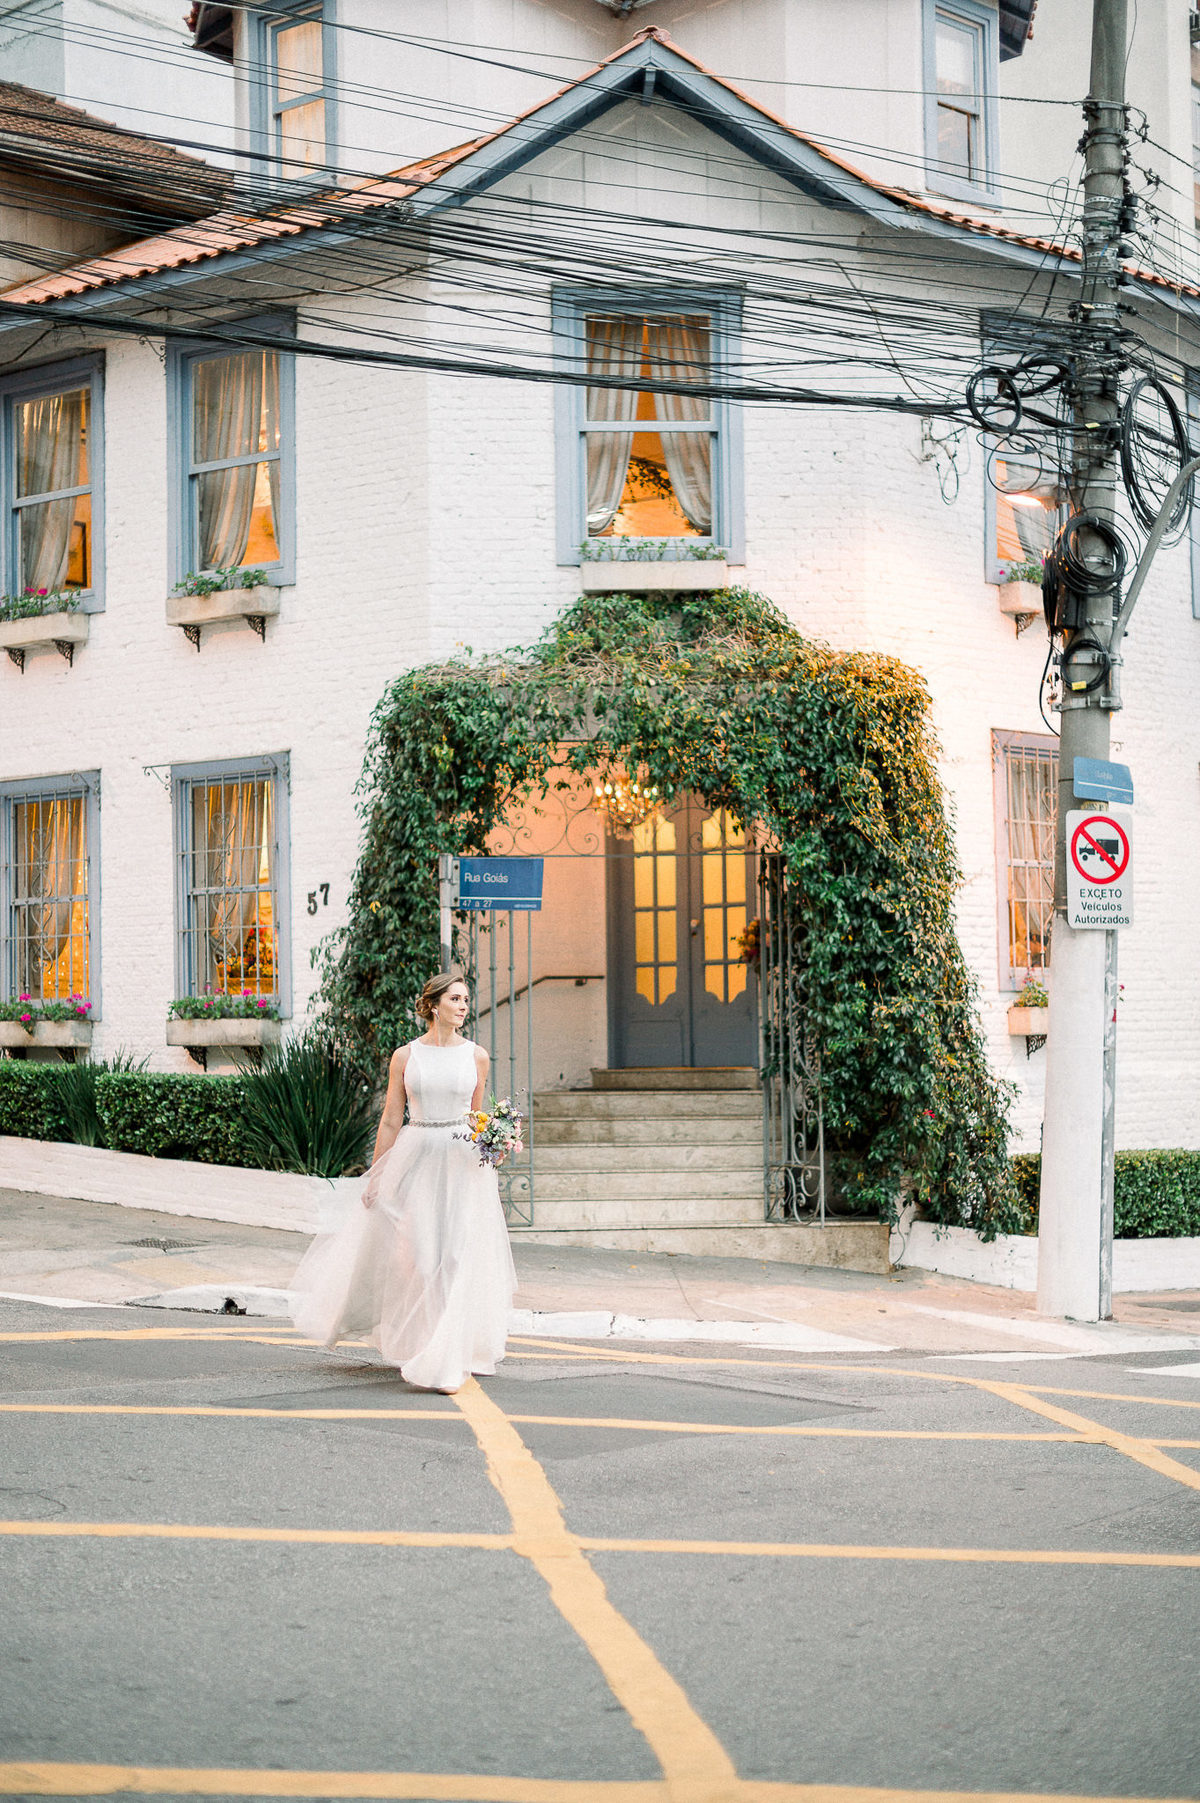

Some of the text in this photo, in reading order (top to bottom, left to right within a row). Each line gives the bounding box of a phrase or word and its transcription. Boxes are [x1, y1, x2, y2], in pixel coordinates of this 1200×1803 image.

[464, 872, 509, 883] Rua Goiás
[1079, 888, 1122, 898] EXCETO
[307, 882, 330, 916] 57
[483, 900, 492, 908] 27
[1081, 901, 1122, 911] Veículos
[1075, 914, 1130, 924] Autorizados
